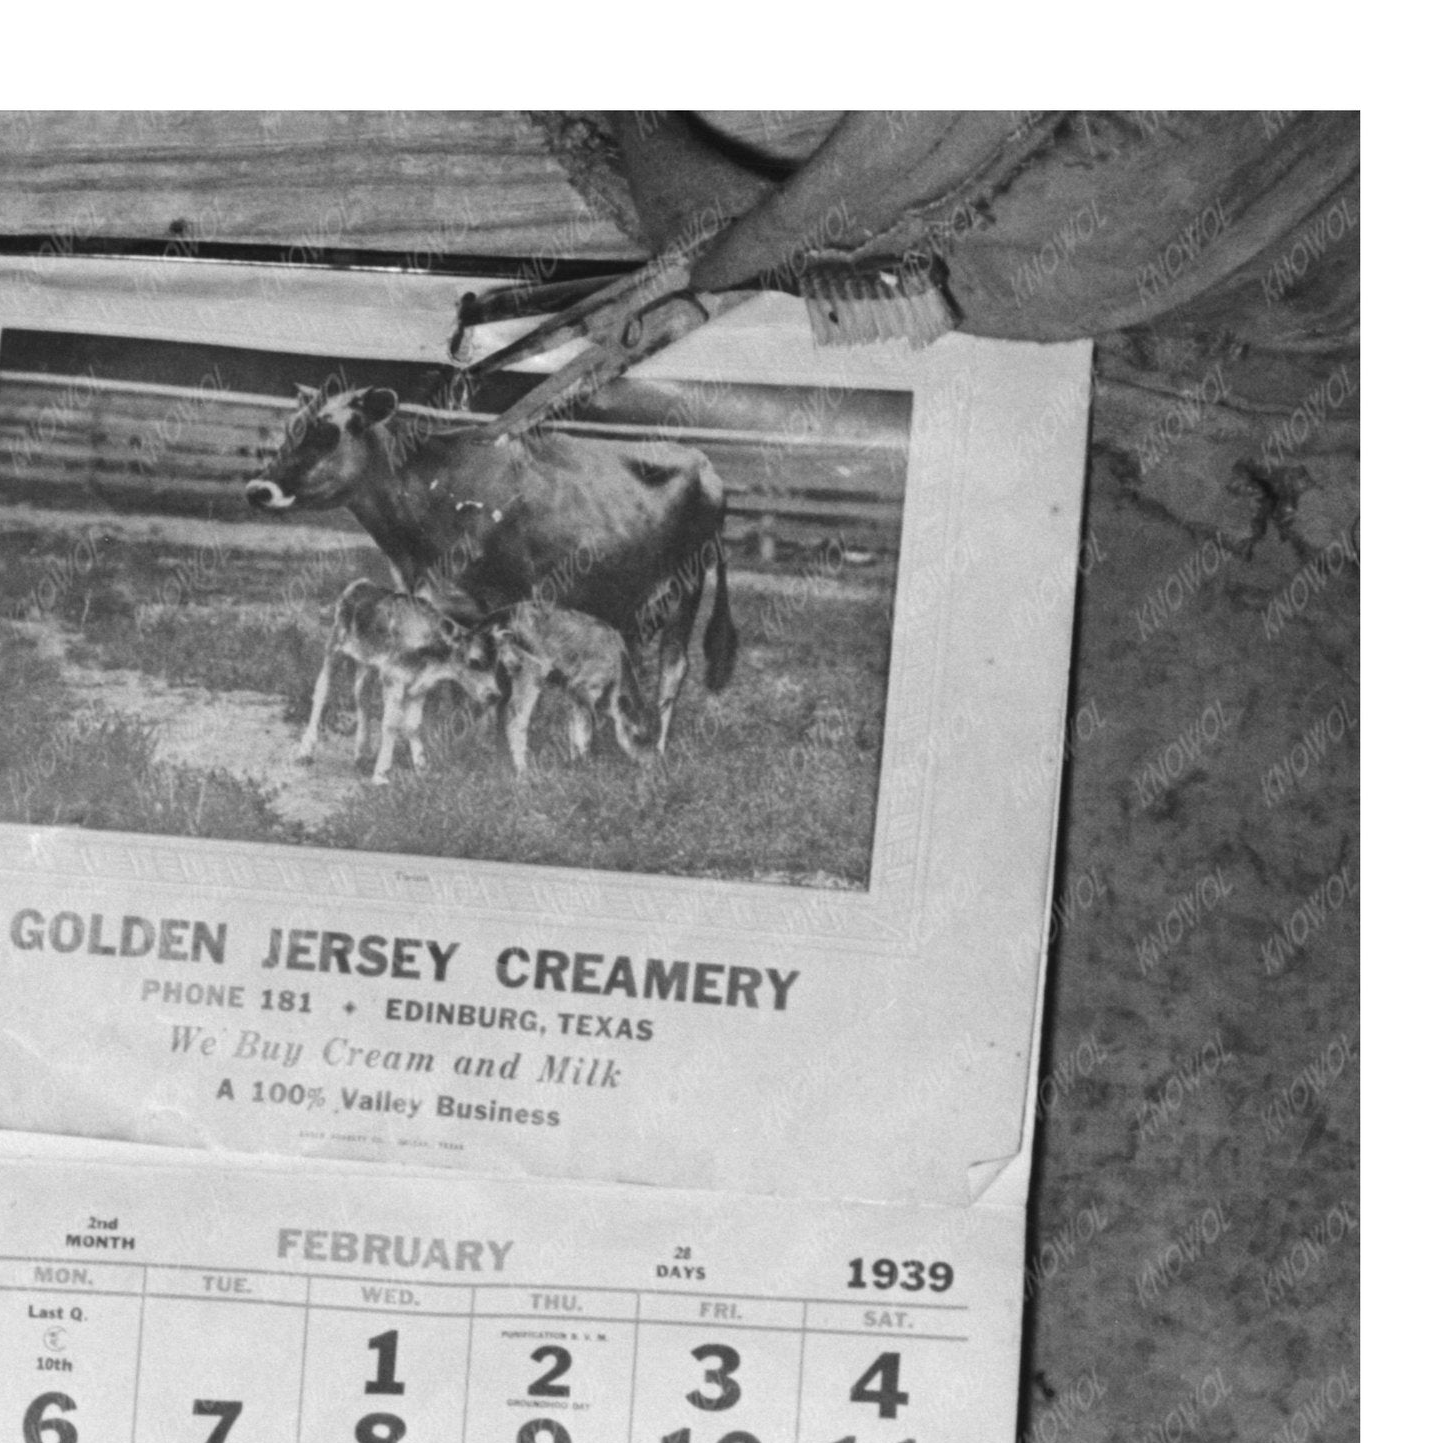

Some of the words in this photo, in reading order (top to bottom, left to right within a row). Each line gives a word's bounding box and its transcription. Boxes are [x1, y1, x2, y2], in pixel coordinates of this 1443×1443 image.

[9, 908, 228, 965] GOLDEN
[261, 926, 461, 982] JERSEY
[495, 946, 802, 1010] CREAMERY
[141, 978, 246, 1009] PHONE
[260, 989, 313, 1013] 181
[385, 998, 547, 1037] EDINBURG,
[557, 1012, 654, 1042] TEXAS
[170, 1023, 217, 1056] We
[233, 1029, 305, 1068] Buy
[322, 1035, 436, 1073] Cream
[453, 1050, 522, 1081] and
[536, 1053, 623, 1089] Milk
[216, 1078, 235, 1101] A
[251, 1080, 326, 1112] 100%
[340, 1086, 423, 1120] Valley
[436, 1095, 562, 1127] Business
[65, 1234, 136, 1251] MONTH
[656, 1263, 707, 1281] DAYS
[87, 1216, 119, 1231] 2nd
[276, 1227, 515, 1273] FEBRUARY
[673, 1246, 692, 1261] 28
[846, 1257, 956, 1293] 1939
[27, 1304, 64, 1320] Last
[69, 1307, 89, 1322] Q.
[33, 1265, 95, 1286] MON.
[201, 1275, 253, 1295] TUE.
[360, 1285, 421, 1307] WED.
[530, 1293, 584, 1312] THU.
[699, 1301, 743, 1320] FRI.
[863, 1310, 914, 1329] SAT.
[35, 1357, 73, 1373] 10th
[364, 1329, 406, 1396] 1
[526, 1344, 574, 1398] 2
[684, 1343, 742, 1412] 3
[848, 1351, 910, 1420] 4
